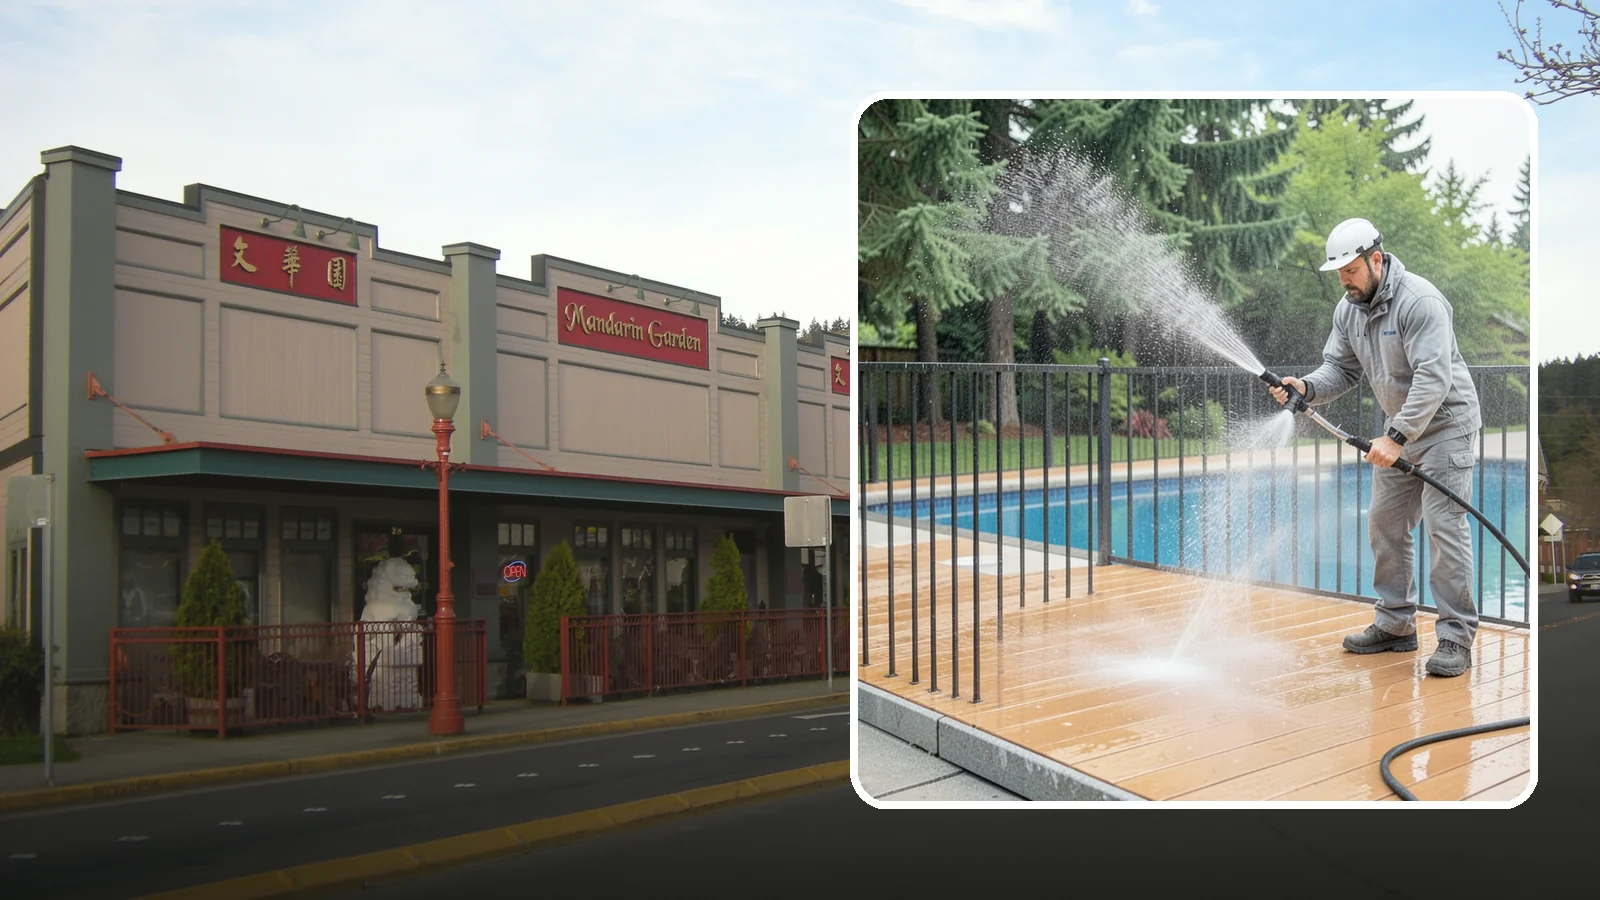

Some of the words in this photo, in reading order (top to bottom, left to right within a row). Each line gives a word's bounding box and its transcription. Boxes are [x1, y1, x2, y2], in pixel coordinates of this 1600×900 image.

[231, 235, 346, 291] 文華園
[564, 302, 644, 341] Mandarin
[648, 320, 702, 352] Garden
[503, 565, 527, 578] OPEN
